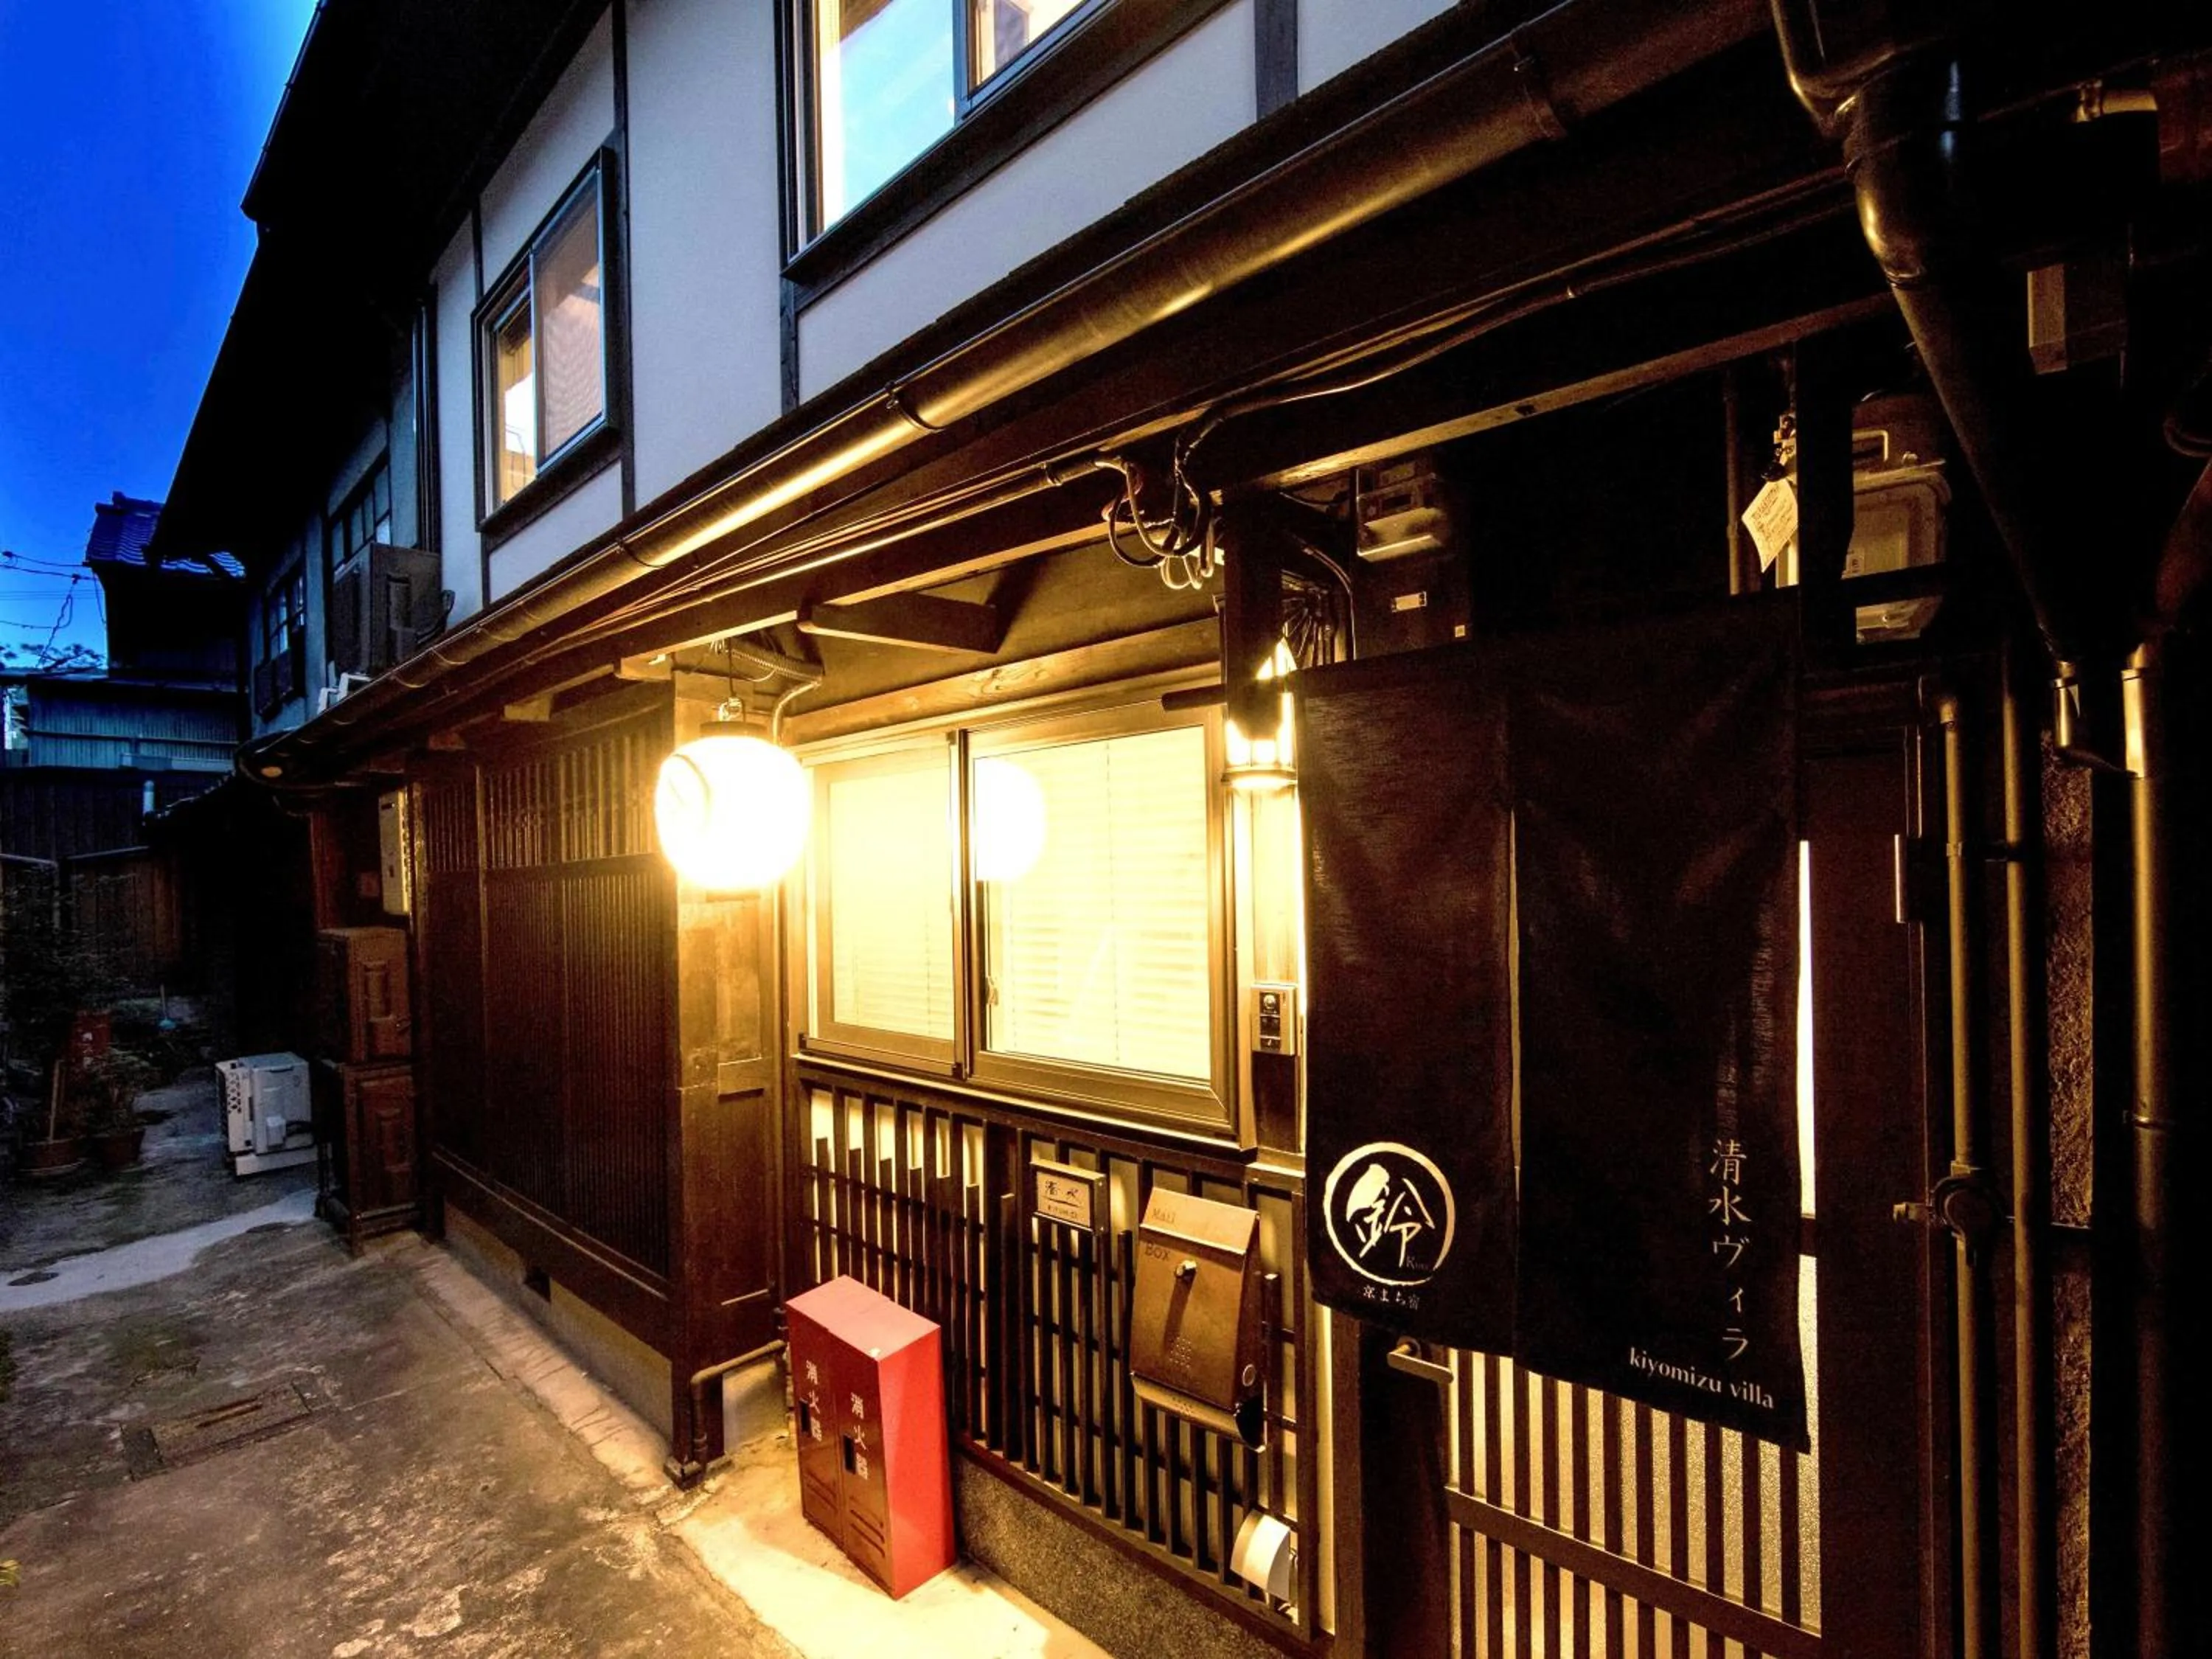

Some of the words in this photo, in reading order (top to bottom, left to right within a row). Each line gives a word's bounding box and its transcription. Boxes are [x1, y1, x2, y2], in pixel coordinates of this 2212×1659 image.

[1708, 1138, 1753, 1360] 清水ヴィラ
[805, 1359, 823, 1443] 消火器
[1629, 1346, 1722, 1393] kiyomizu
[1729, 1380, 1775, 1409] villa
[850, 1391, 869, 1481] 消火器
